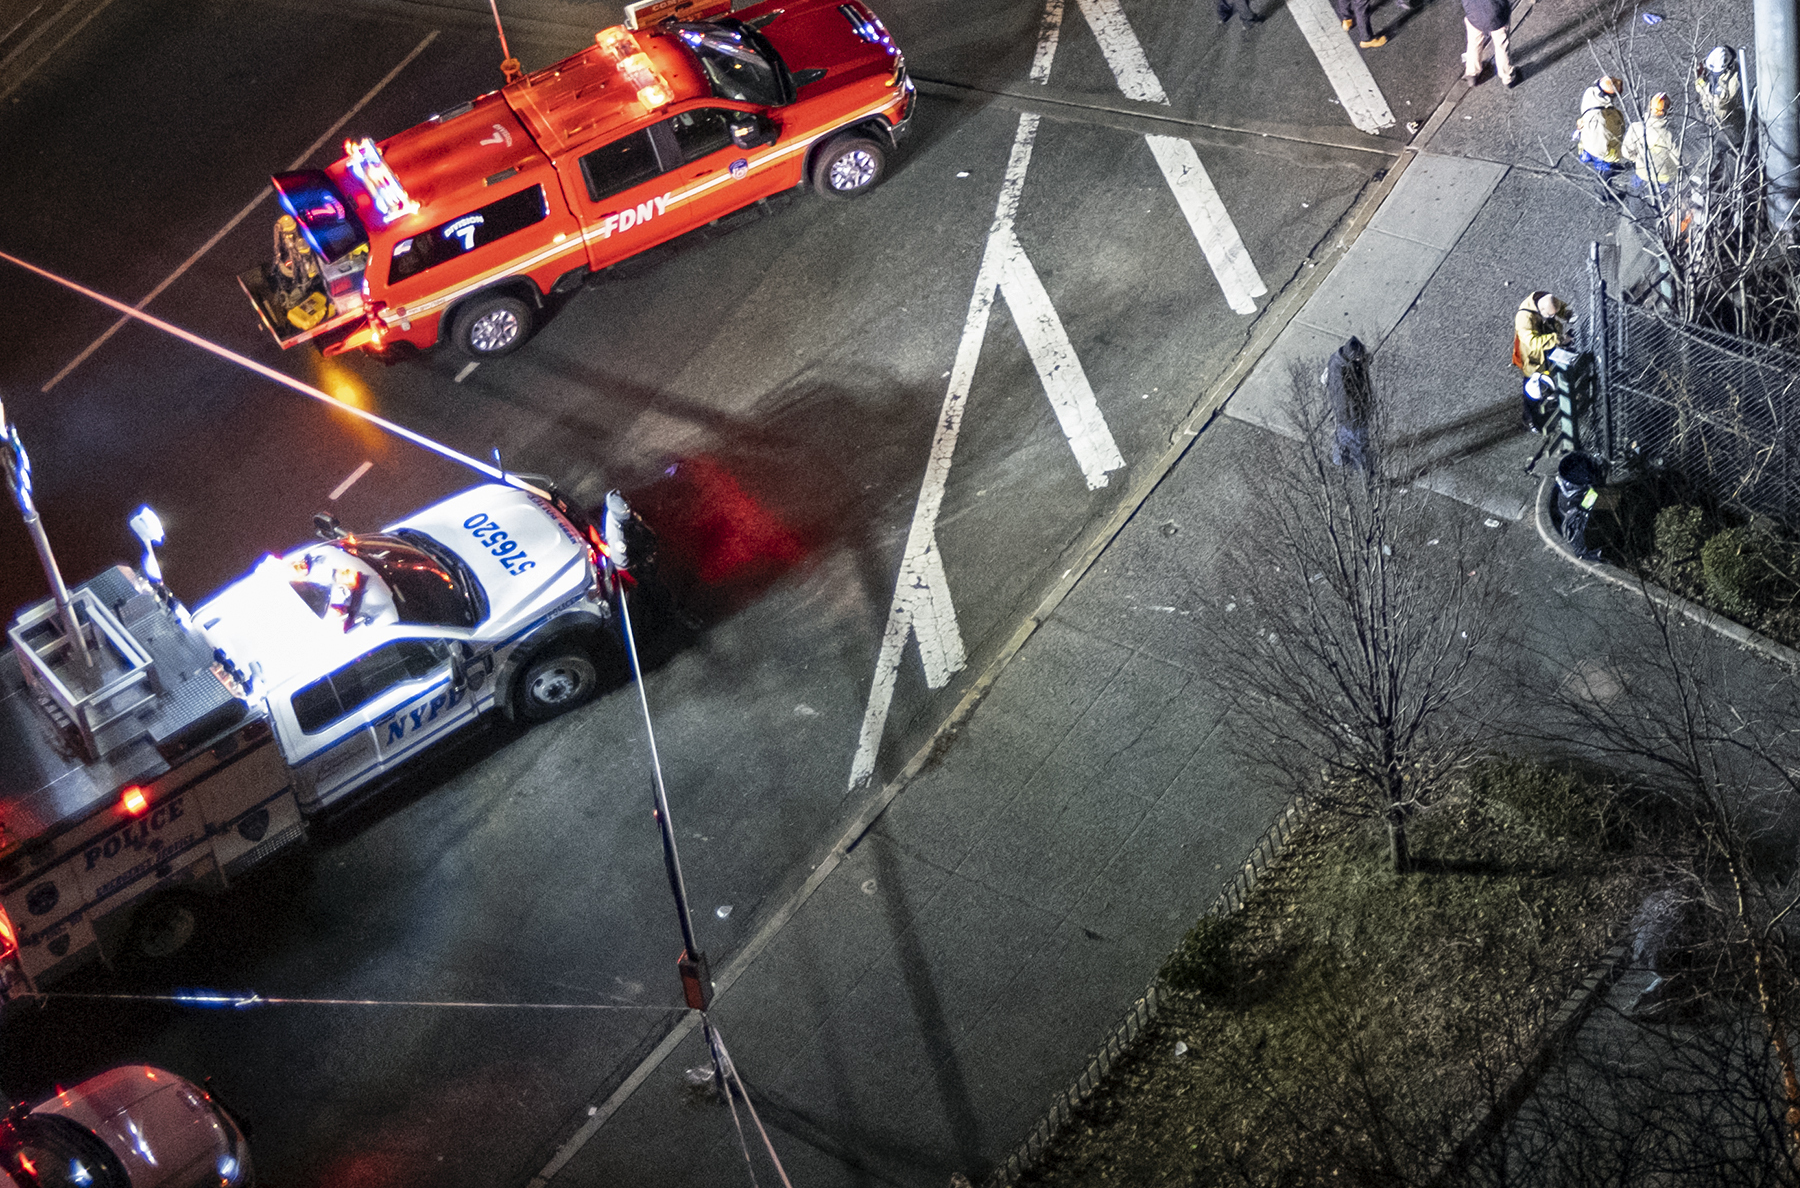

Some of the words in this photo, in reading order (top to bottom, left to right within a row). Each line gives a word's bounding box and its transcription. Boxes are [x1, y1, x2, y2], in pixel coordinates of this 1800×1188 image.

[479, 131, 504, 146] 7
[443, 214, 484, 238] DIVISION
[456, 224, 475, 250] 7
[602, 191, 671, 238] FDNY
[463, 513, 536, 576] 576520
[386, 685, 466, 746] NYPD
[84, 798, 184, 871] POLICE
